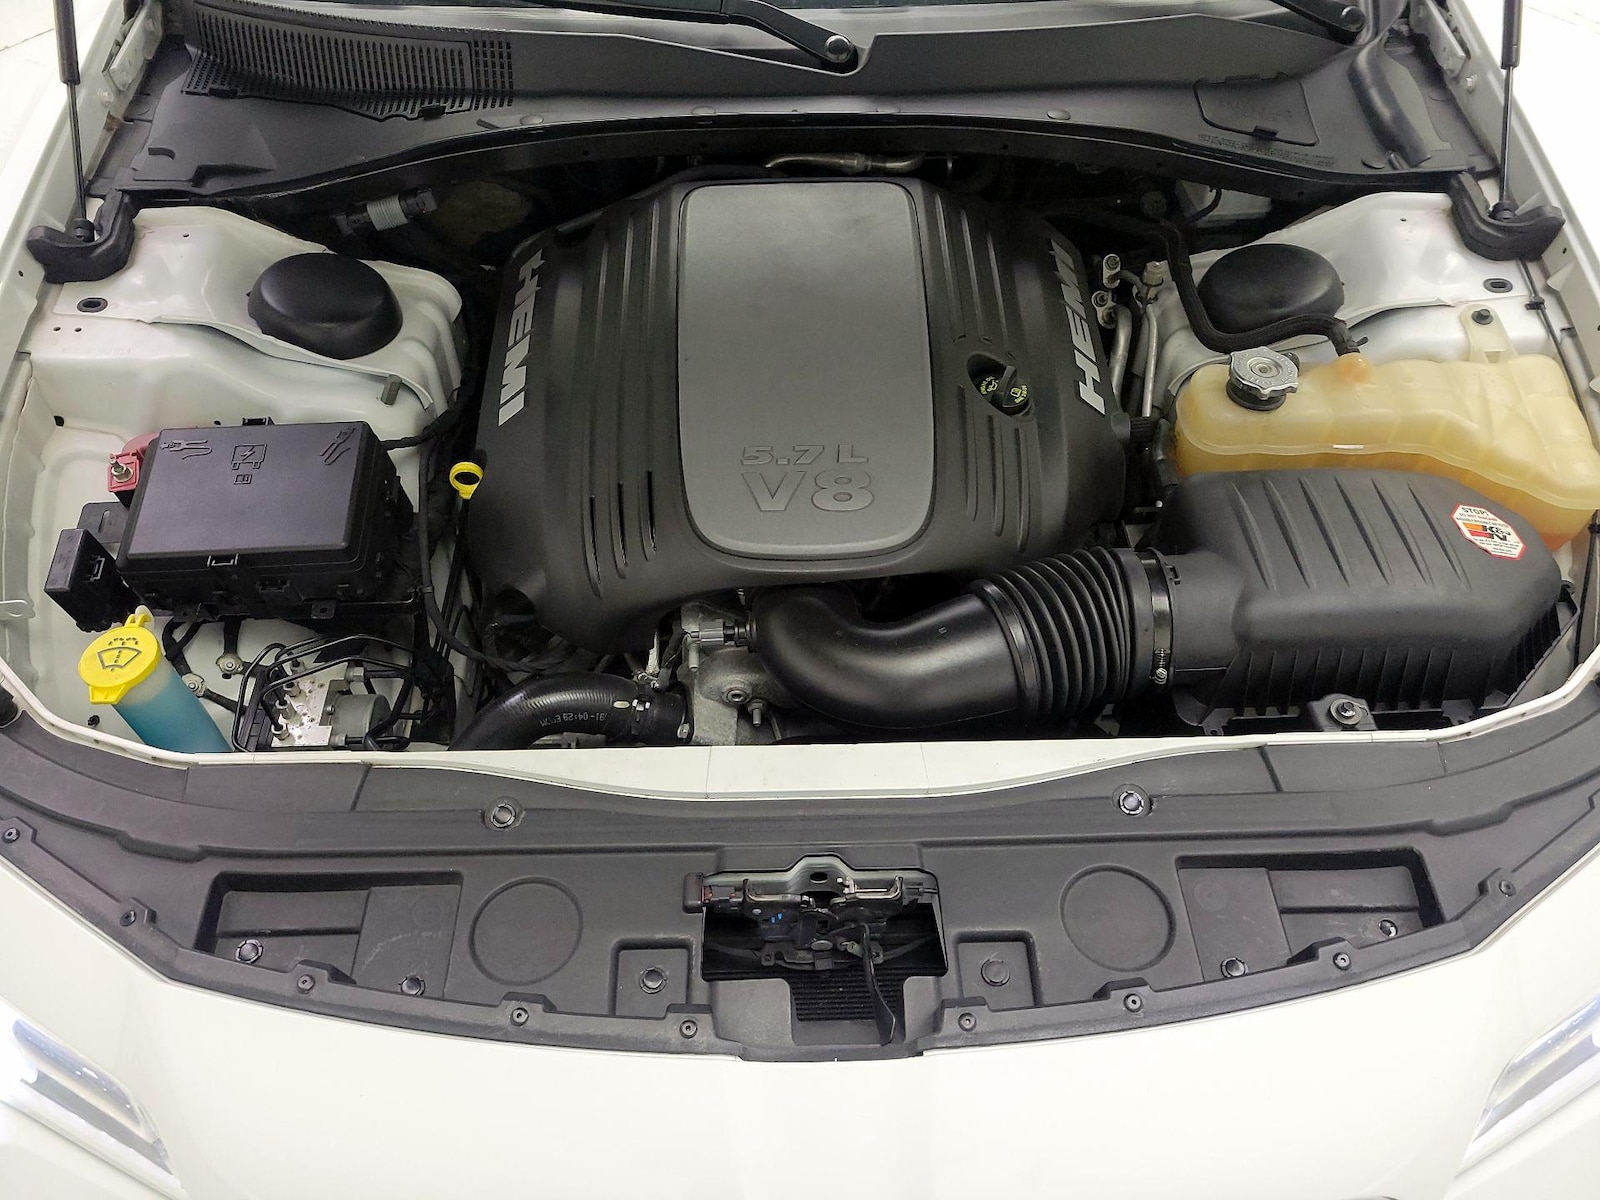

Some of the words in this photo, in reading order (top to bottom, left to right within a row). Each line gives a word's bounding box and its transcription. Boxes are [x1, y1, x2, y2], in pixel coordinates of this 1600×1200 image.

[498, 249, 542, 427] HEMI
[1050, 239, 1106, 415] HEMI
[741, 469, 875, 512] V8
